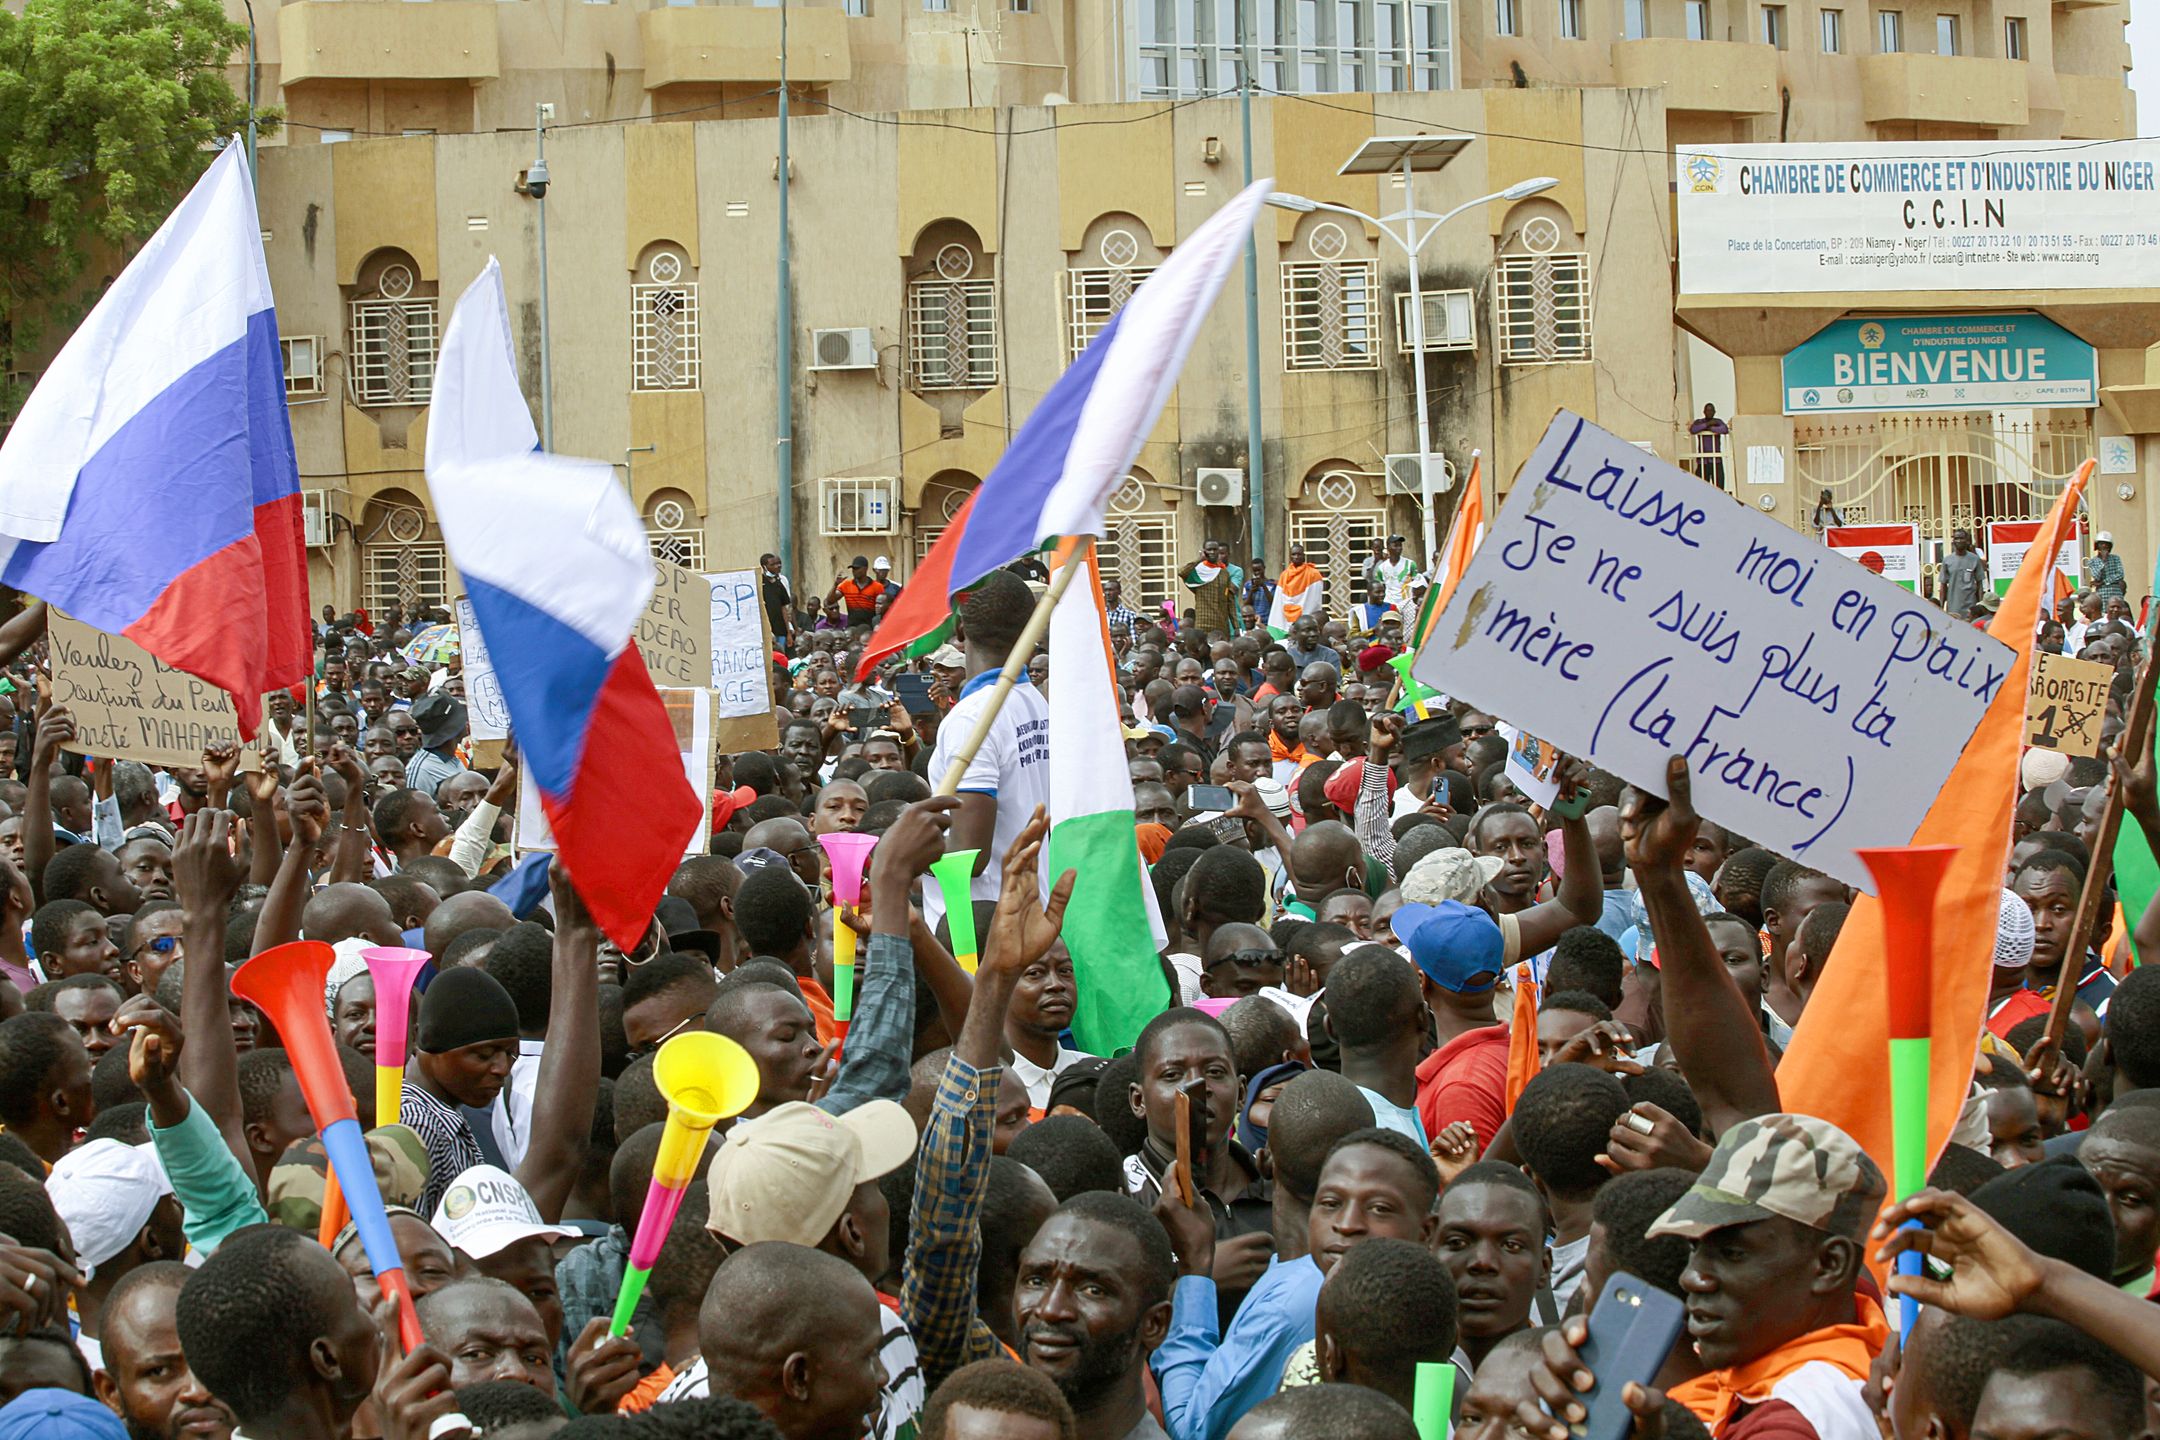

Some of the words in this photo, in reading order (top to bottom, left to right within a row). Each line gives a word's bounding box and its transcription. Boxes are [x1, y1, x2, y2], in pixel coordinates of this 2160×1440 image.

[1740, 164, 1820, 195] CHAMBRE
[1825, 164, 1845, 194] DE
[1850, 162, 1942, 194] COMMERCE
[1946, 162, 1966, 191] ET
[1971, 161, 2072, 191] D'INDUSTRIE
[2078, 161, 2099, 190] DU
[2105, 161, 2155, 191] NIGER
[1728, 239, 1750, 251] Place
[1753, 239, 1762, 250] de
[1765, 239, 1773, 250] la
[1831, 238, 1842, 249] BP
[1850, 237, 1864, 249] 209
[1866, 237, 1895, 251] Niamey
[1952, 236, 1975, 247] 00227
[1978, 236, 1987, 247] 20
[1989, 235, 1998, 247] 73
[2001, 235, 2010, 247] 22
[2013, 235, 2021, 247] 10
[2028, 235, 2037, 246] 20
[2040, 235, 2049, 246] 73
[2052, 235, 2060, 246] 51
[2063, 235, 2072, 246] 55
[2079, 235, 2094, 246] Fax
[2101, 235, 2123, 246] 00227
[2125, 235, 2134, 246] 20
[2137, 235, 2146, 246] 73
[2148, 234, 2157, 246] 46
[1819, 253, 1843, 266] E-mail
[2020, 251, 2035, 262] web
[2042, 251, 2099, 265] www.ccaian.org
[1901, 326, 1942, 336] CHAMBRE
[1944, 326, 1955, 335] DE
[1957, 325, 2005, 334] COMMERCE
[2006, 324, 2016, 333] ET
[1913, 337, 1966, 346] D'INDUSTRIE
[1967, 337, 1980, 345] DU
[1981, 336, 2007, 344] NIGER
[1833, 348, 2047, 385] BIENVENUE
[1545, 417, 1706, 548] Laisse
[1736, 537, 1819, 607] moi
[1832, 590, 1877, 641] en
[711, 583, 755, 622] SP
[1485, 599, 1595, 681] mère
[1502, 514, 1576, 571] Je
[1588, 548, 1642, 602] ne
[1648, 589, 1741, 664] suis
[1738, 632, 1840, 714] plus
[1851, 680, 1897, 748] ta
[151, 679, 185, 711] du
